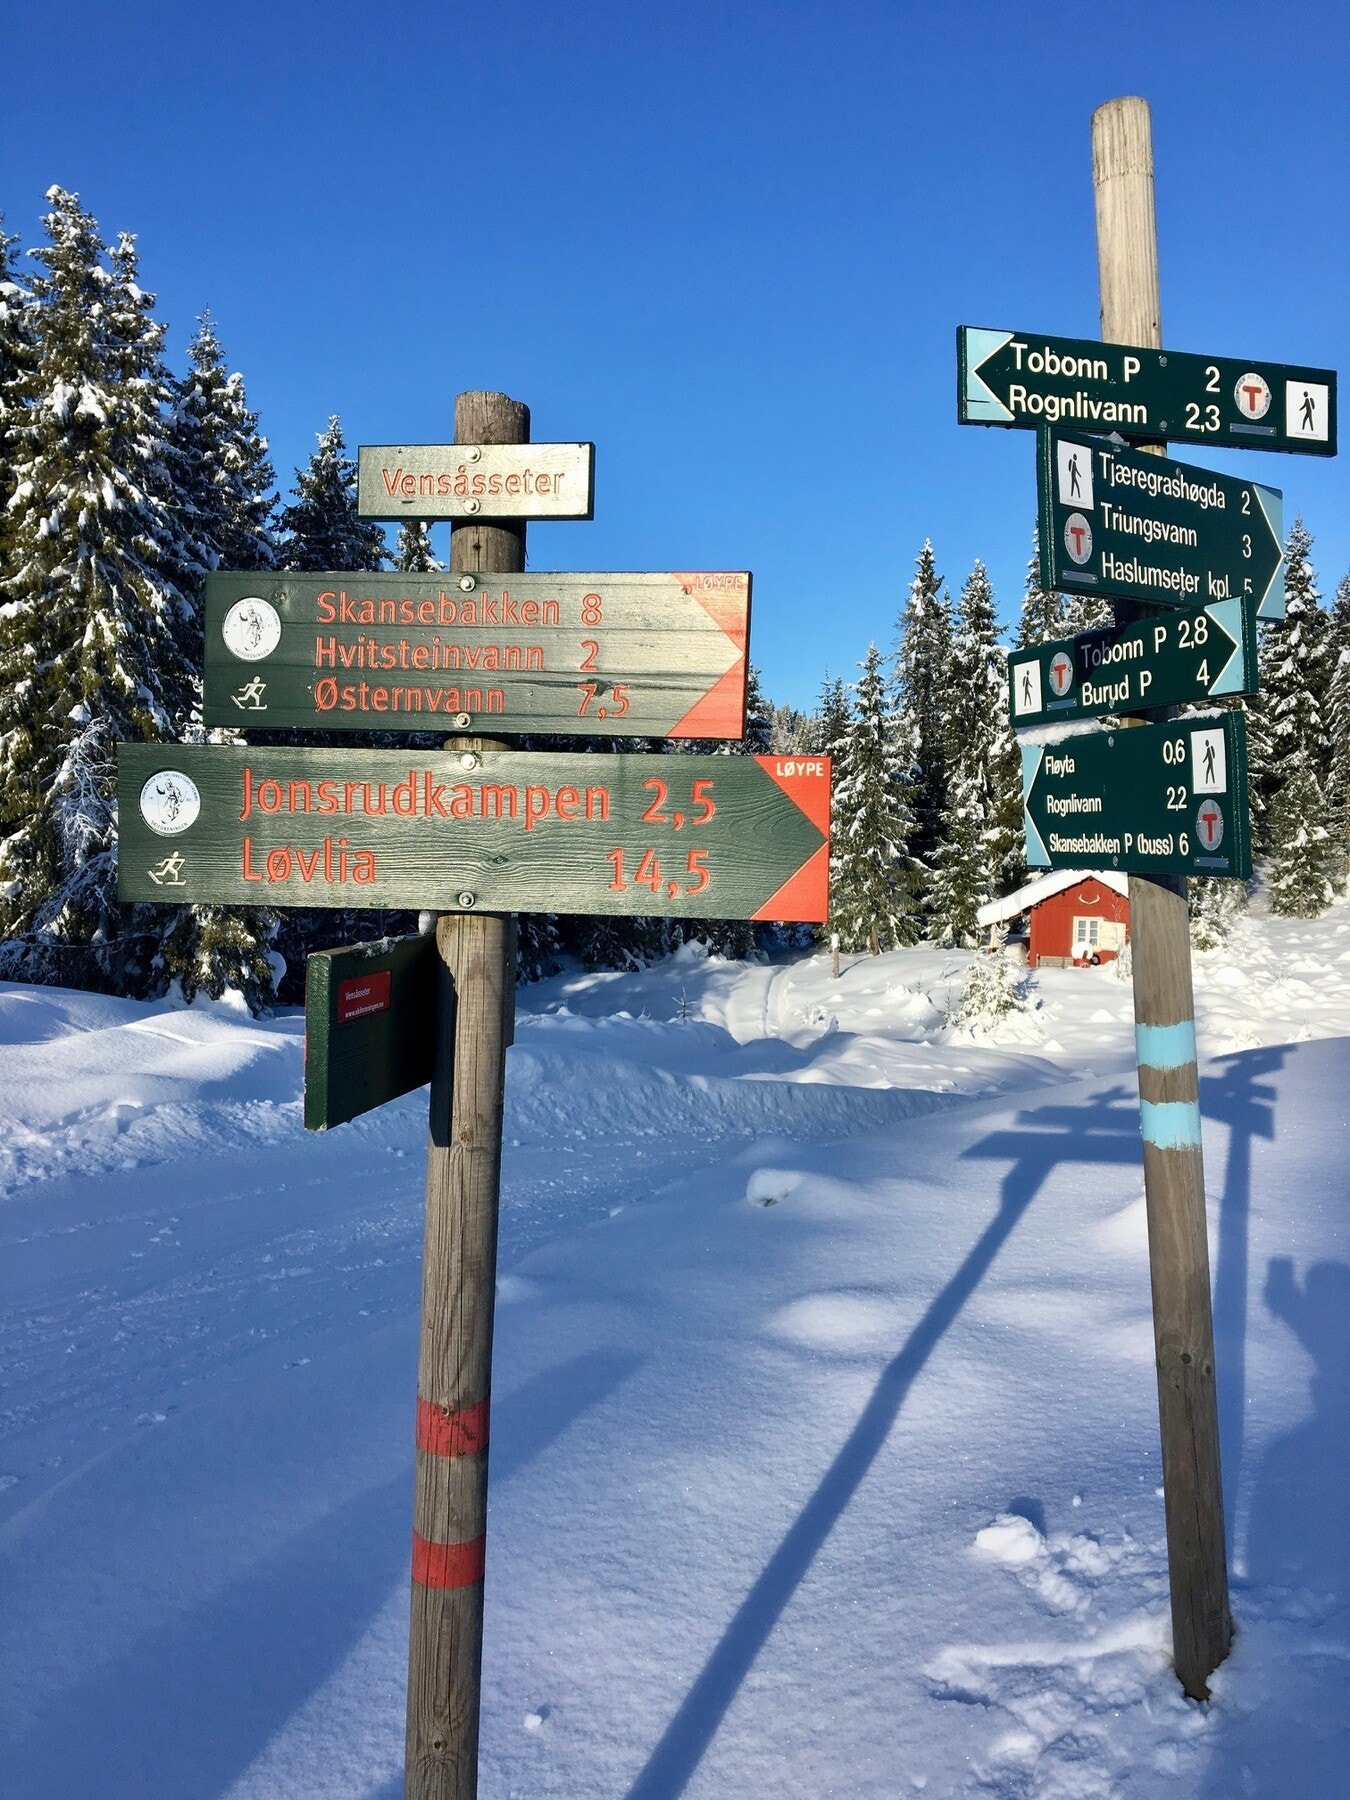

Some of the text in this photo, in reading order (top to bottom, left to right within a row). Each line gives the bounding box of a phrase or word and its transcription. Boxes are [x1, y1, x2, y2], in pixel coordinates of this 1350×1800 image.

[1010, 342, 1107, 381] Tobonn
[1124, 356, 1141, 383] P
[1205, 366, 1220, 393] 2
[1009, 385, 1220, 432] Rognlivann 2,3
[382, 465, 565, 496] Vensåsseter
[1099, 452, 1250, 515] Tjæregrashøgda 2
[1101, 502, 1252, 558] Triungsvann 3
[695, 575, 743, 591] LØYPE
[1102, 552, 1199, 595] Haslumseter
[1209, 571, 1232, 600] kpl.
[316, 590, 561, 625] Skansebakken
[580, 594, 603, 626] 8
[314, 633, 599, 671] Hvitsteinvann 2
[1081, 616, 1208, 669] Tobonn P 2,8
[314, 677, 630, 721] Østernvann 7,5
[1082, 659, 1210, 707] Burud P 4
[776, 762, 824, 777] LØYPE
[1045, 739, 1186, 778] Fløyta 0,6
[239, 768, 716, 831] Jonsrudkampen 2,5
[1047, 786, 1187, 817] Rognlivann 2,2
[1049, 832, 1189, 856] Skansebakken P (buss) 6
[242, 836, 711, 899] Løvlia 14,5
